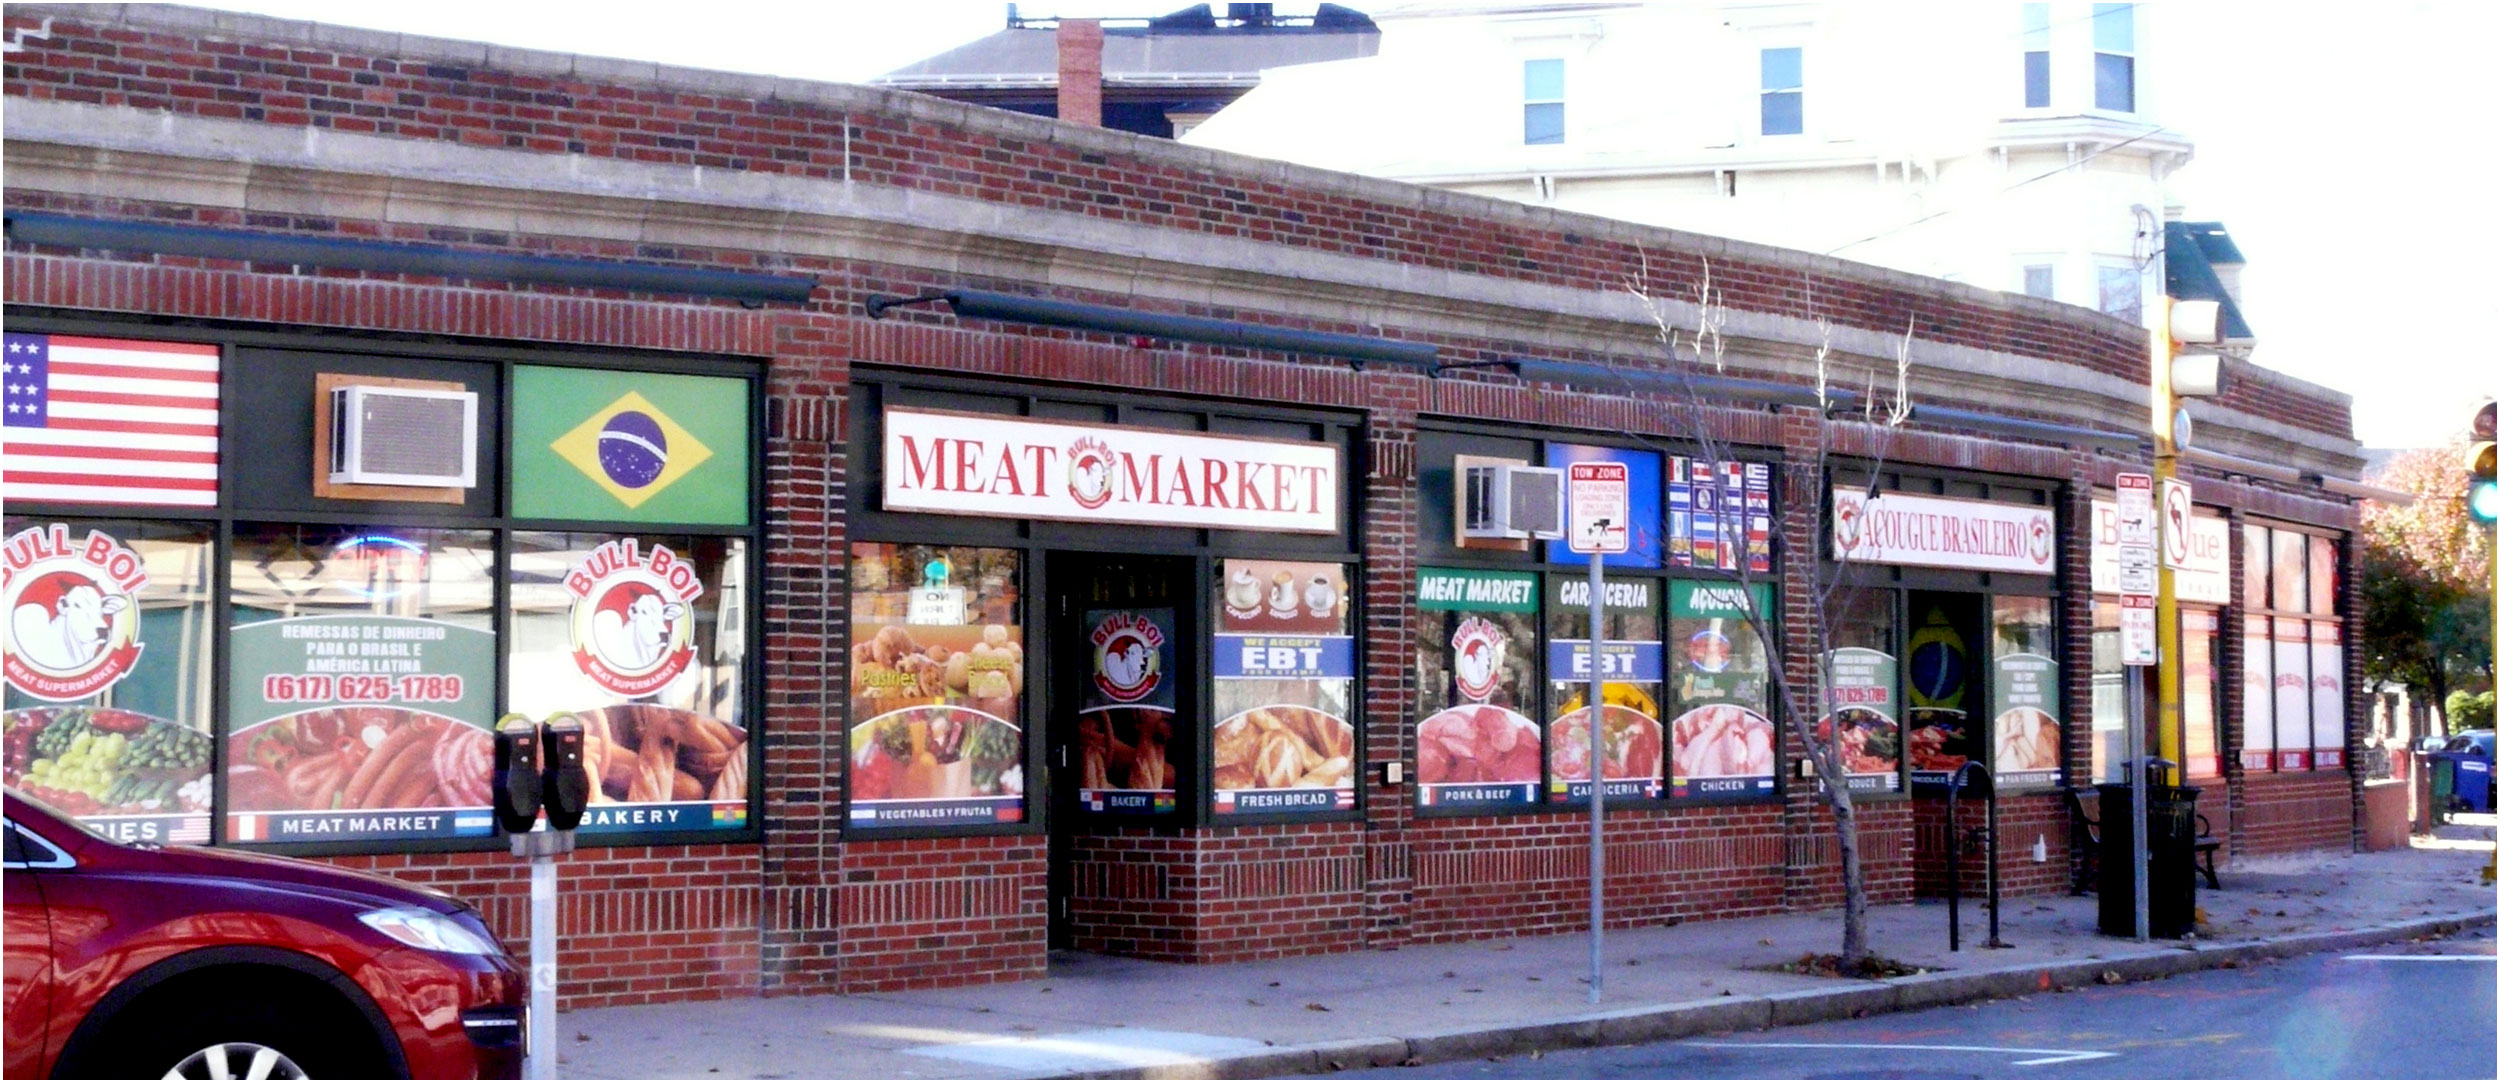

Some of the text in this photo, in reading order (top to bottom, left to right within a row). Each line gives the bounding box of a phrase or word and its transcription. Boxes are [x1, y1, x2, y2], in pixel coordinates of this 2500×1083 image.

[900, 434, 1329, 514] MEAT MARKET
[1573, 467, 1623, 479] TOW ZONE
[1864, 509, 1937, 559] AÇOUGUE
[1941, 515, 2027, 559] BRASILEIRO
[84, 535, 147, 592] BOI
[568, 543, 700, 600] BULL BOI
[1420, 576, 1533, 604] MEAT MARKET
[1561, 581, 1648, 608] CARICERIA
[282, 625, 446, 640] REMESSAS DE DINHEIRO
[1093, 614, 1164, 646] BULL BOI
[1454, 619, 1479, 647] BULL
[306, 643, 421, 656] PARA O BRASIL E
[1244, 638, 1321, 647] WE ACCEPT
[306, 656, 421, 673] AMÉRICA LATINA
[1241, 646, 1323, 669] EBT
[1573, 653, 1636, 673] EBT
[8, 658, 119, 693] MEAT SUPERMARKET
[589, 659, 679, 690] MEAT SUPERMARKET
[861, 669, 916, 687] Pastries
[266, 675, 461, 700] (617) 625-1789
[1446, 788, 1511, 800] PORK & BEEF
[1572, 783, 1640, 797] CAICERIA
[1701, 780, 1745, 791] CHICKEN
[1111, 796, 1146, 807] BAKERY
[1241, 793, 1327, 807] FRESH BREAD
[580, 809, 679, 826] BAKERY
[879, 807, 992, 819] VEGETABLES Y FRUTAS
[283, 816, 441, 834] MEAT MARKET
